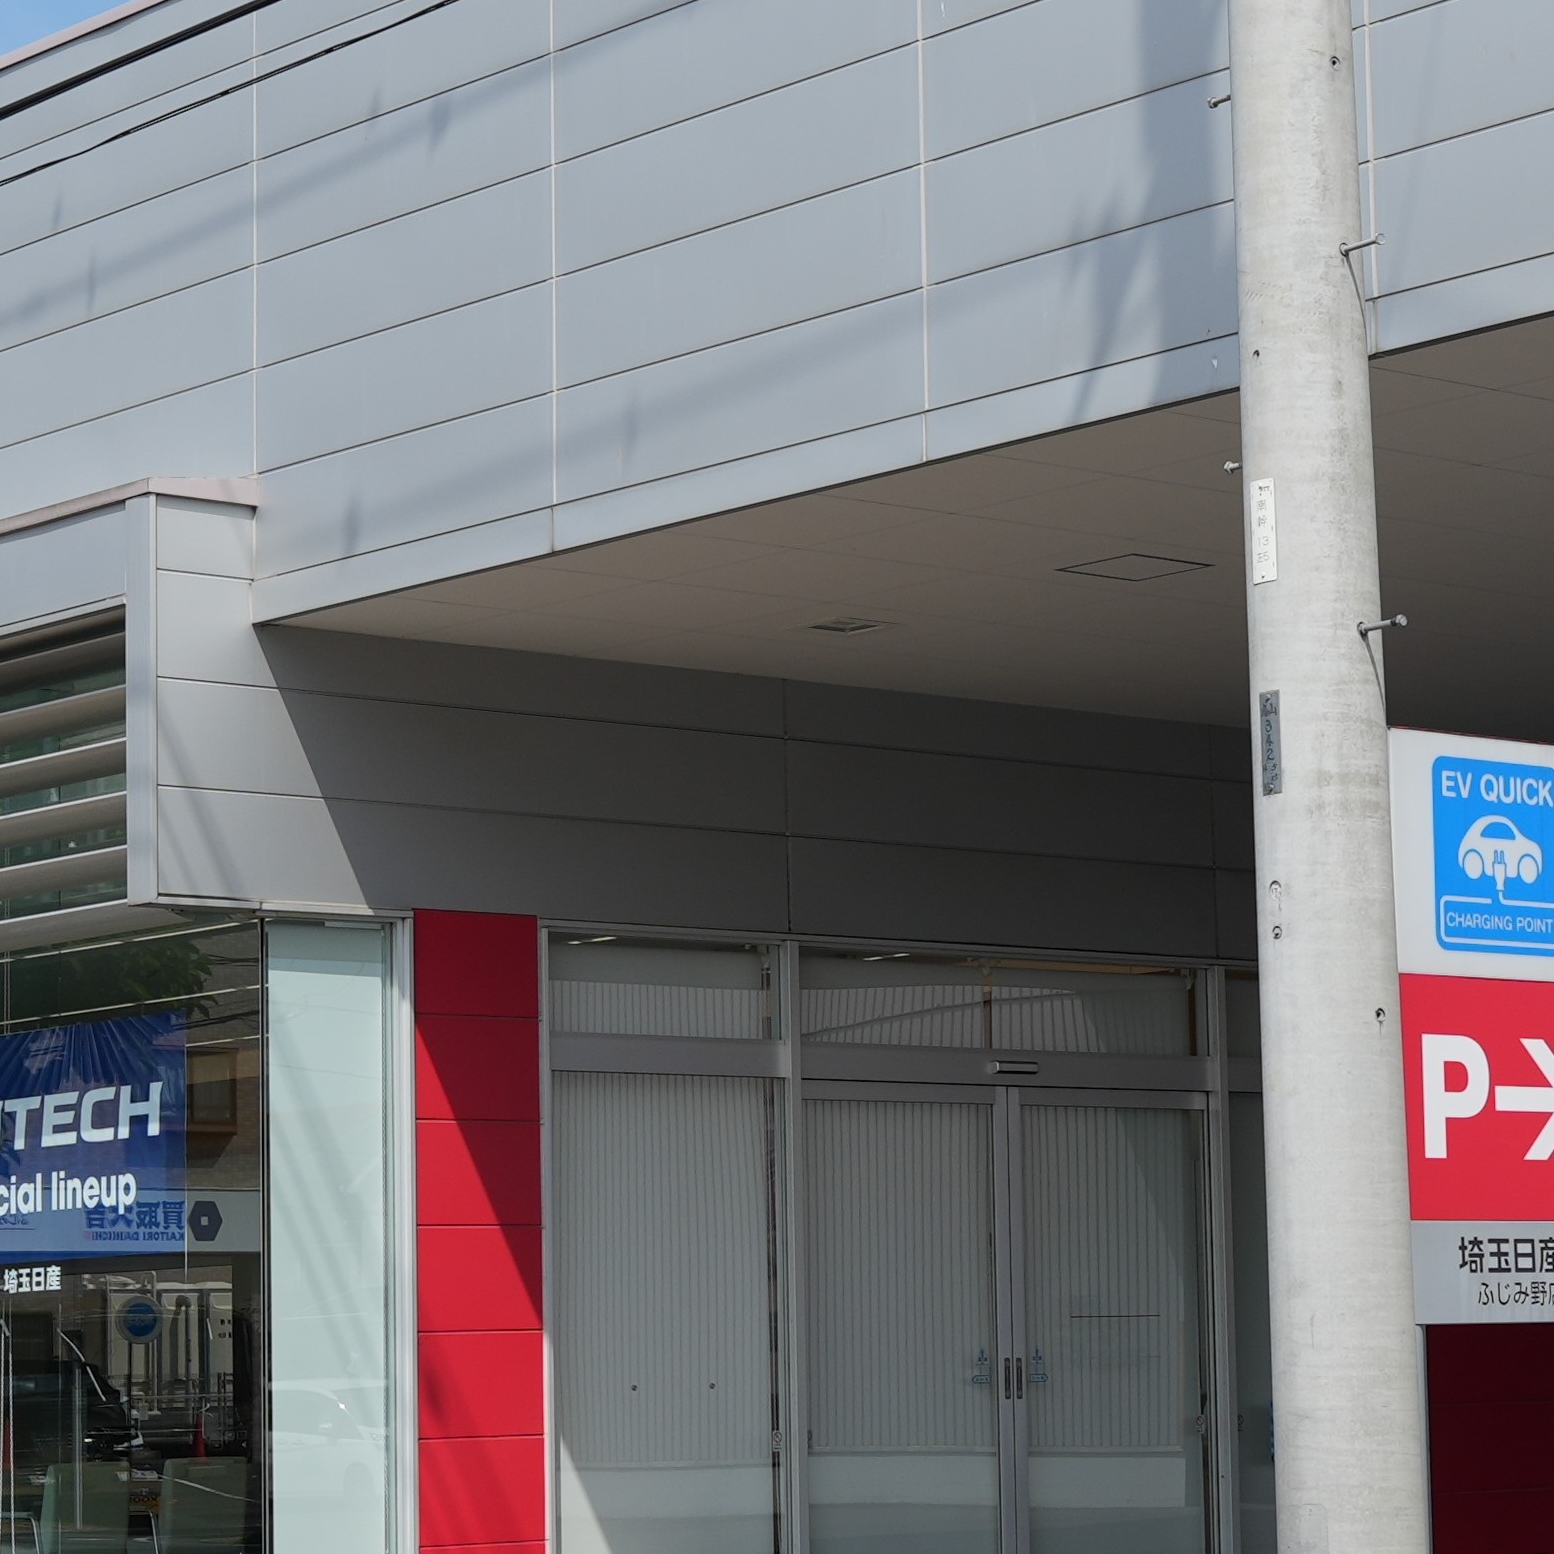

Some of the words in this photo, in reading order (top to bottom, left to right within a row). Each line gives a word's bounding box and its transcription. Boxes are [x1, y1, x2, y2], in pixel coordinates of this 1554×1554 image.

[1441, 770, 1472, 798] EV
[1480, 773, 1554, 808] QUICK
[1446, 911, 1512, 931] CHARGING
[1517, 917, 1554, 934] POINT
[1421, 1033, 1490, 1159] P
[51, 1170, 137, 1214] lineup
[3, 1264, 62, 1294] 埼玉日産
